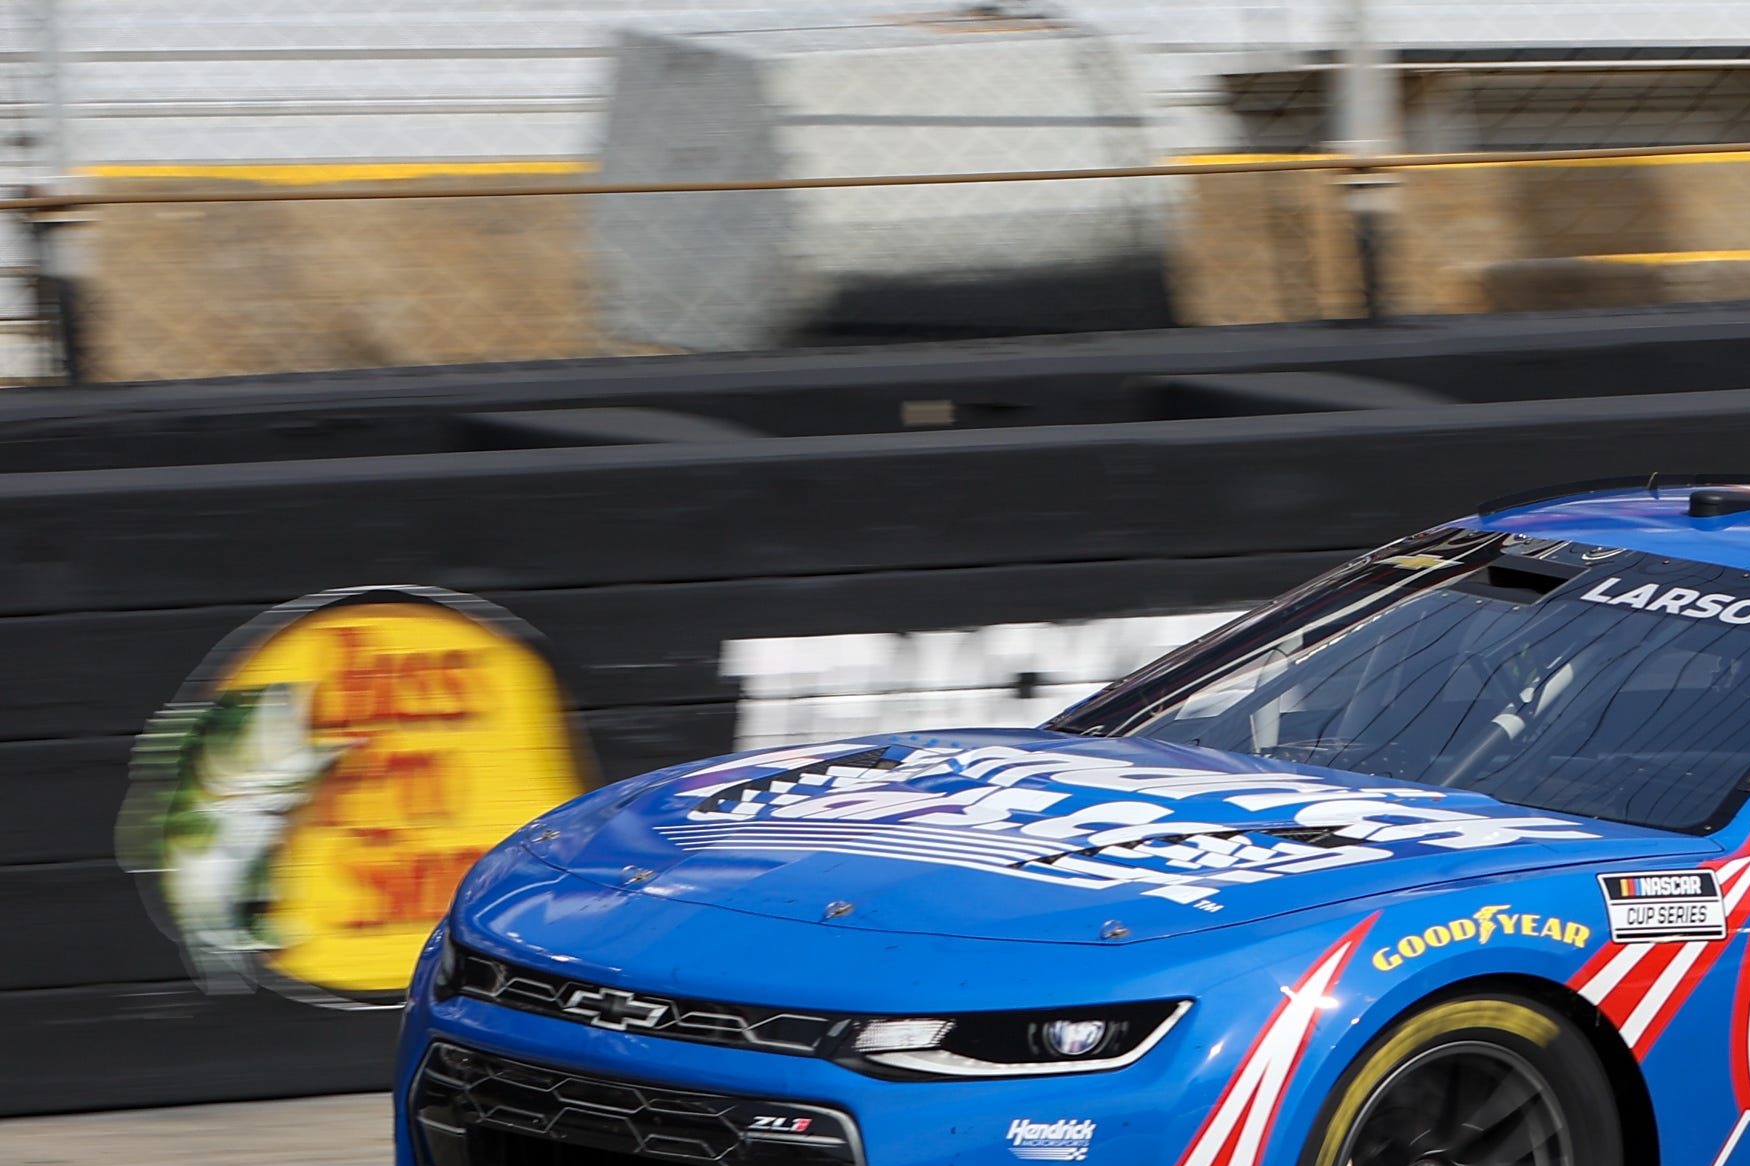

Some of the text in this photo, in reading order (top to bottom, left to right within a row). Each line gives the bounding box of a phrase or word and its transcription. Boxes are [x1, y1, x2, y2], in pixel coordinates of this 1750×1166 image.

[1640, 875, 1702, 897] NASCAR
[1627, 904, 1708, 926] CUP SERIES
[1372, 904, 1592, 972] GOODYEAR
[748, 1115, 813, 1132] ZL1
[1005, 1119, 1097, 1147] Hendrick
